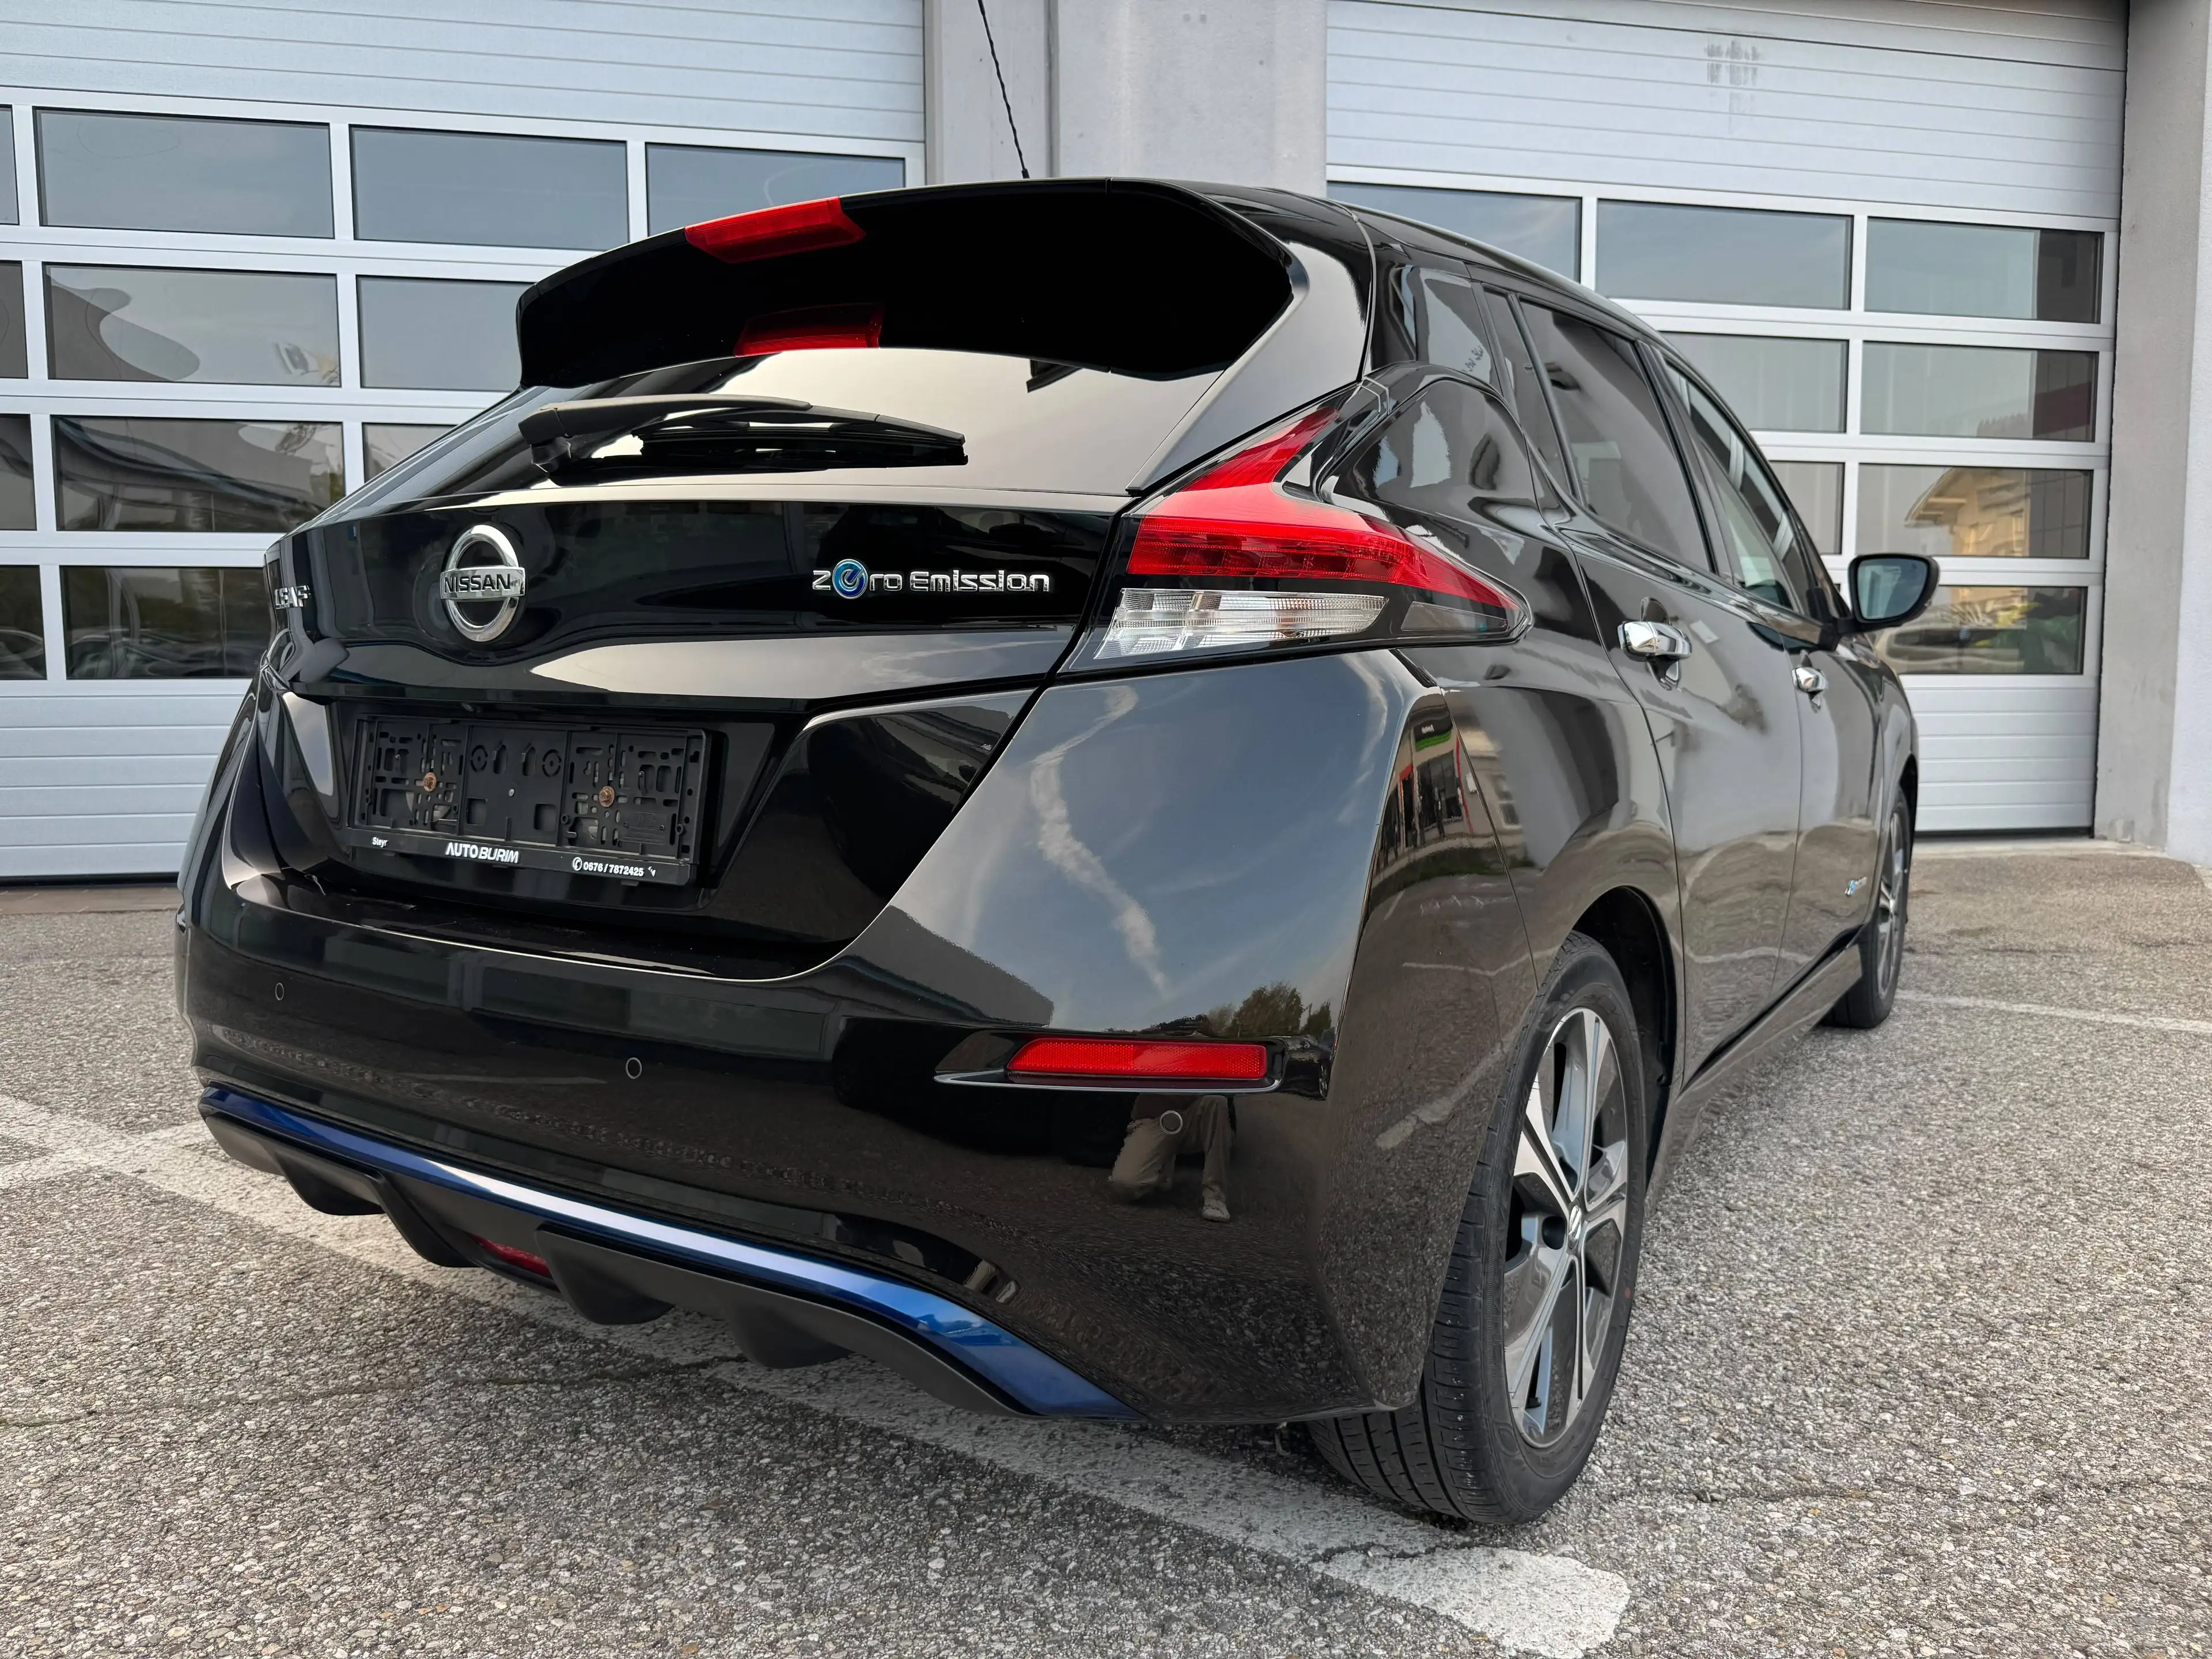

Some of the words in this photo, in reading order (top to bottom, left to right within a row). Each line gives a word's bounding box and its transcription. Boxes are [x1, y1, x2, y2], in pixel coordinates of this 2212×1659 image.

[444, 574, 512, 593] NISSAN
[910, 570, 1050, 592] Emission
[275, 585, 311, 609] LEAF
[372, 836, 389, 849] Steyr
